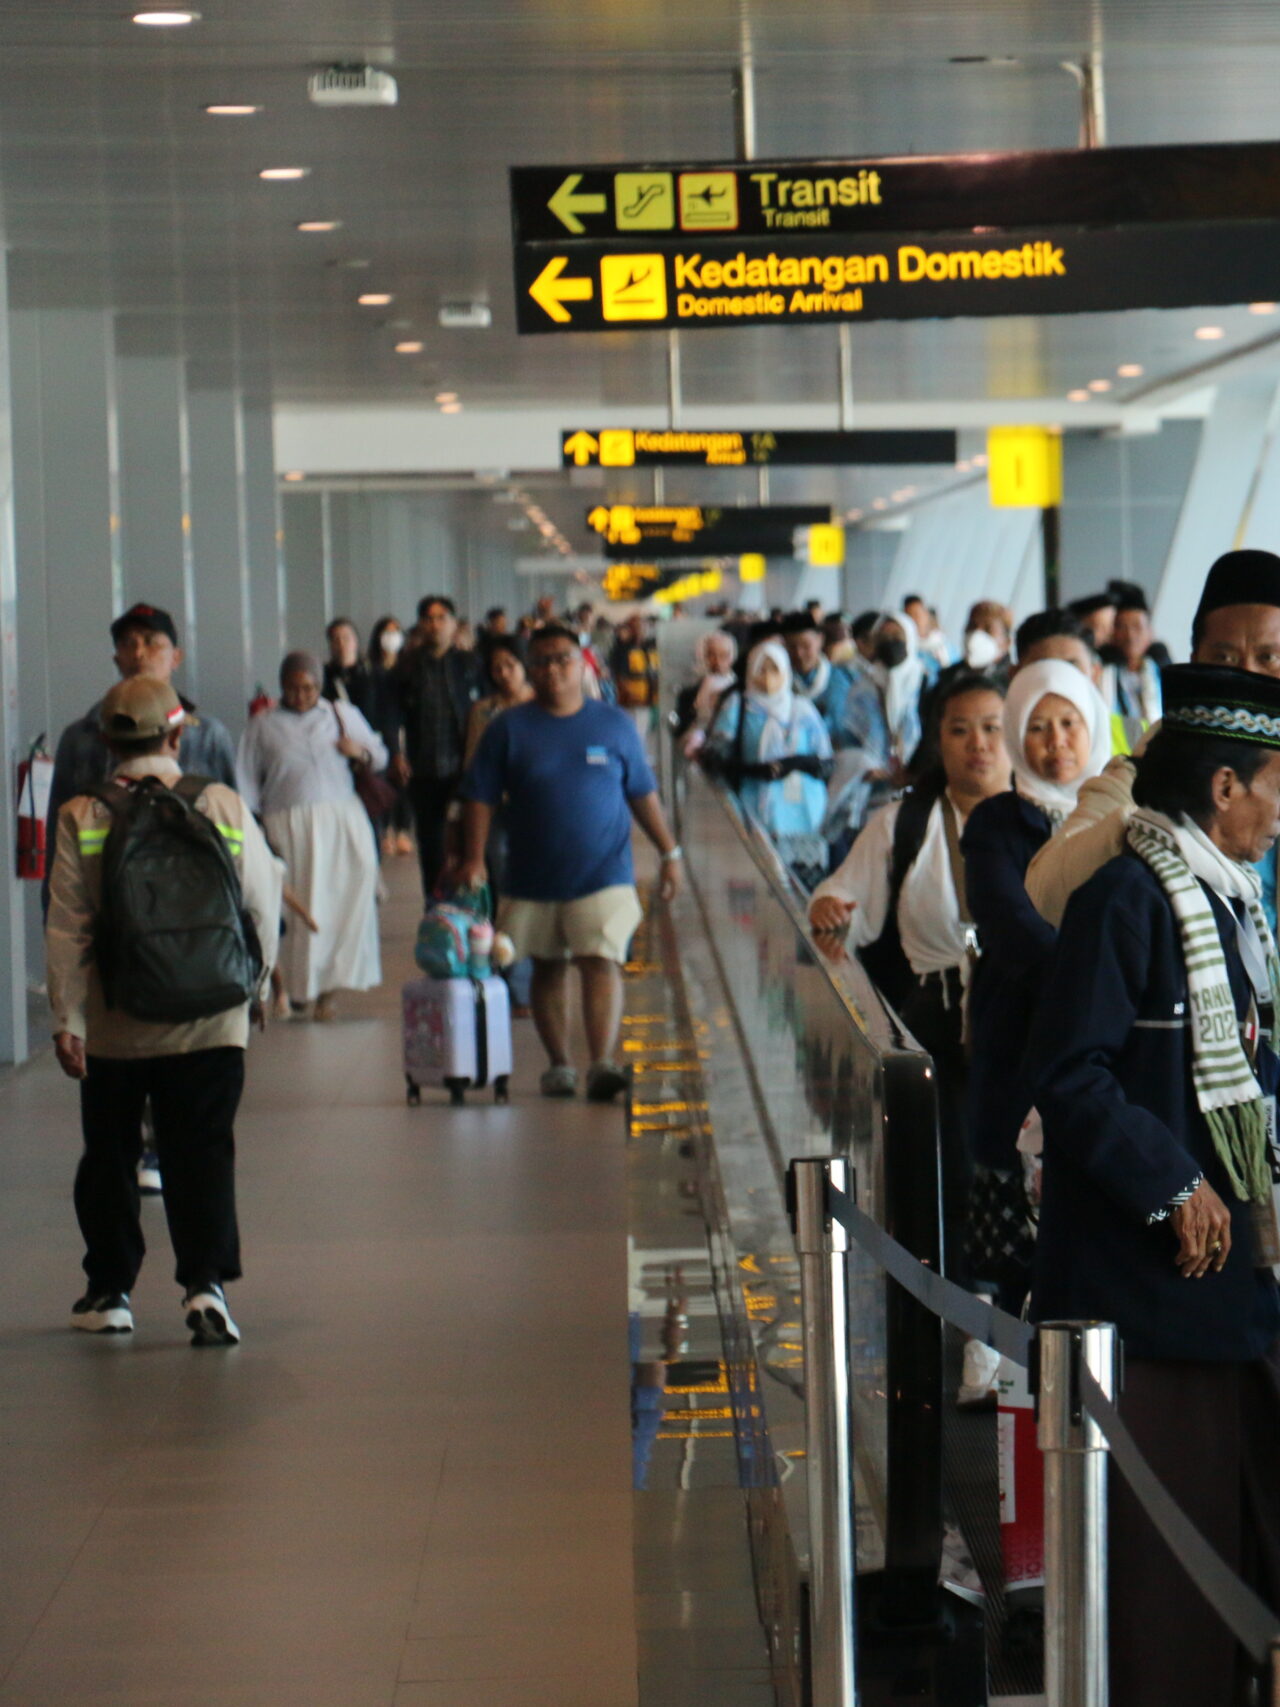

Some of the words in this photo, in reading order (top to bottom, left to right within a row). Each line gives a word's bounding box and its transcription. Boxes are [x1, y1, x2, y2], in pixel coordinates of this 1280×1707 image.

[751, 170, 882, 207] Transit
[764, 208, 830, 227] Transit
[674, 252, 889, 291] Kedatangan
[897, 240, 1066, 283] Domestik
[677, 290, 786, 317] Domestic
[788, 286, 863, 313] Arrival
